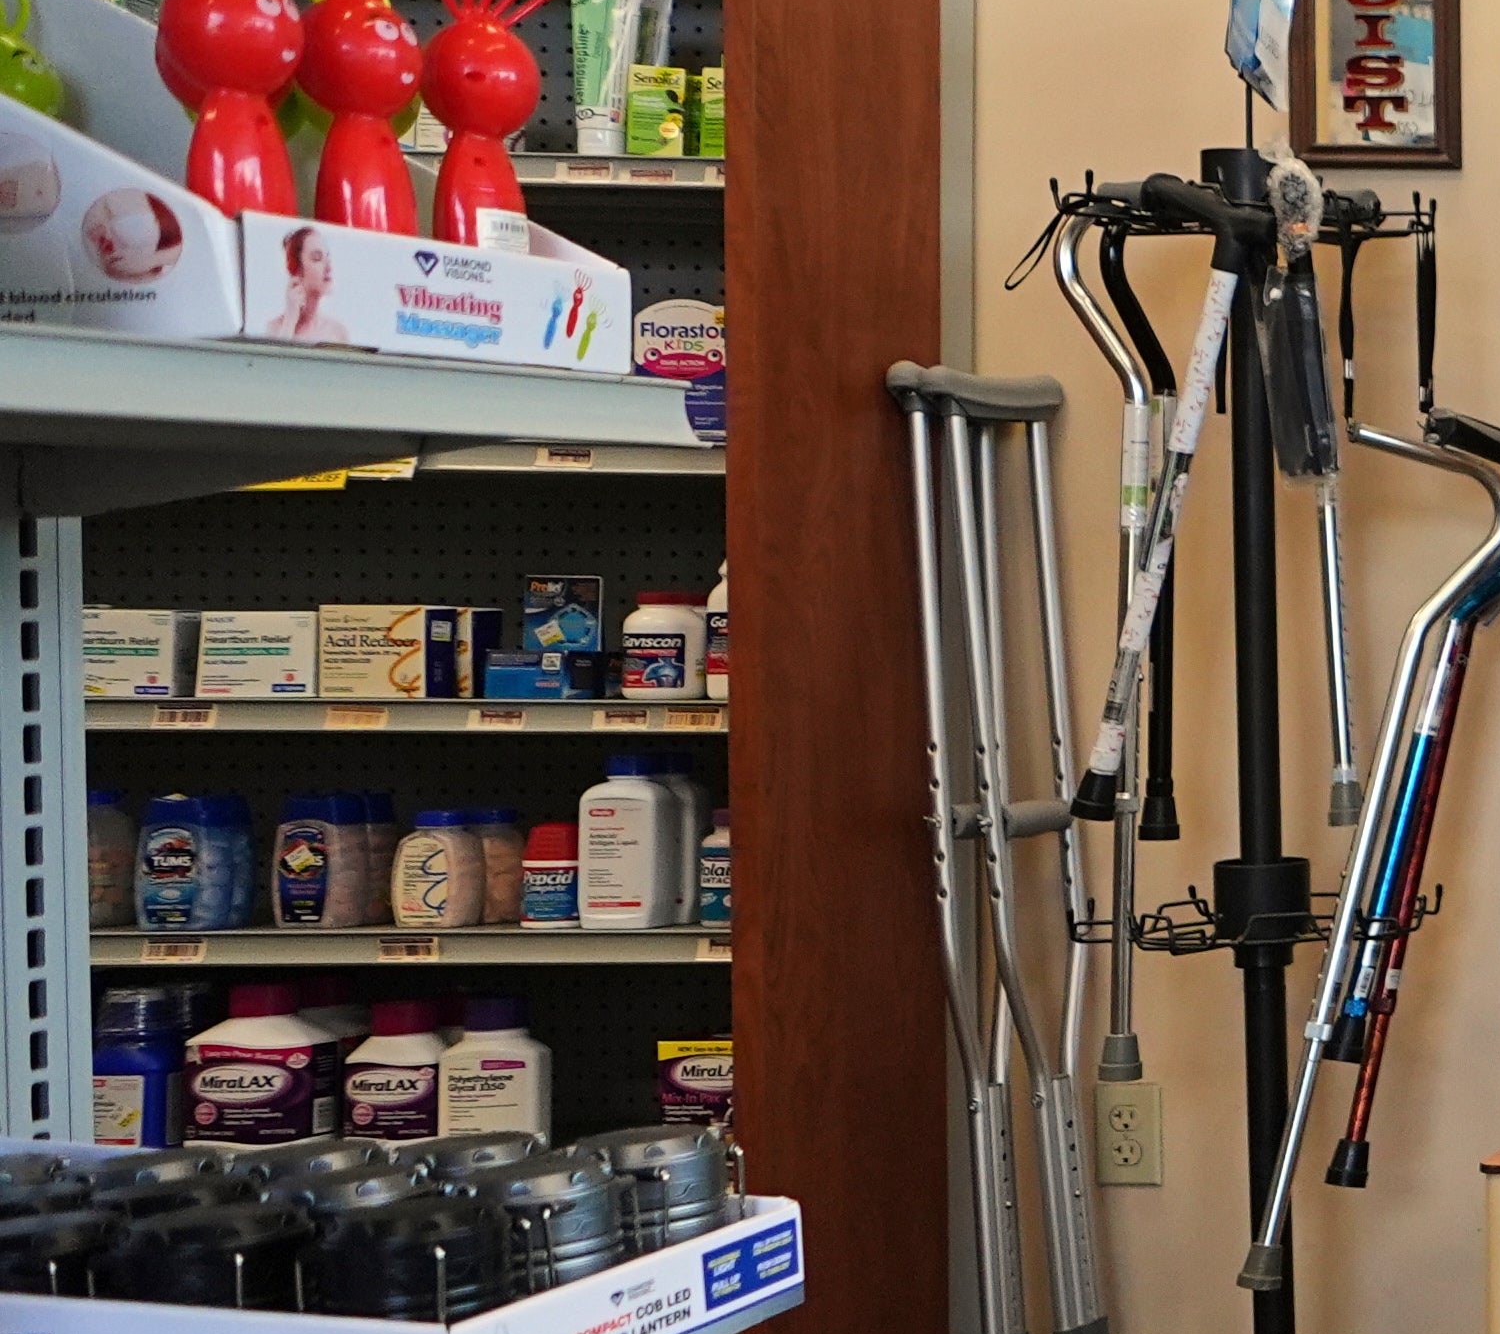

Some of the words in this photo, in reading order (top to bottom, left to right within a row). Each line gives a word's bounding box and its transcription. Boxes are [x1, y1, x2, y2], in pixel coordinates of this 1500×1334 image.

[633, 72, 681, 86] Senokot
[442, 255, 493, 273] DIAMOND
[397, 283, 503, 324] Vibrating
[664, 339, 705, 352] KIDS
[204, 634, 256, 645] Heartburn
[261, 634, 291, 644] Relief
[325, 635, 357, 649] Acid
[360, 634, 415, 649] Reducer
[152, 855, 193, 867] TUMS
[523, 870, 574, 886] Pepcid
[200, 1074, 276, 1090] MiraLAX
[352, 1078, 419, 1092] MiraLAX
[635, 1300, 663, 1321] COB
[667, 1287, 692, 1308] LED
